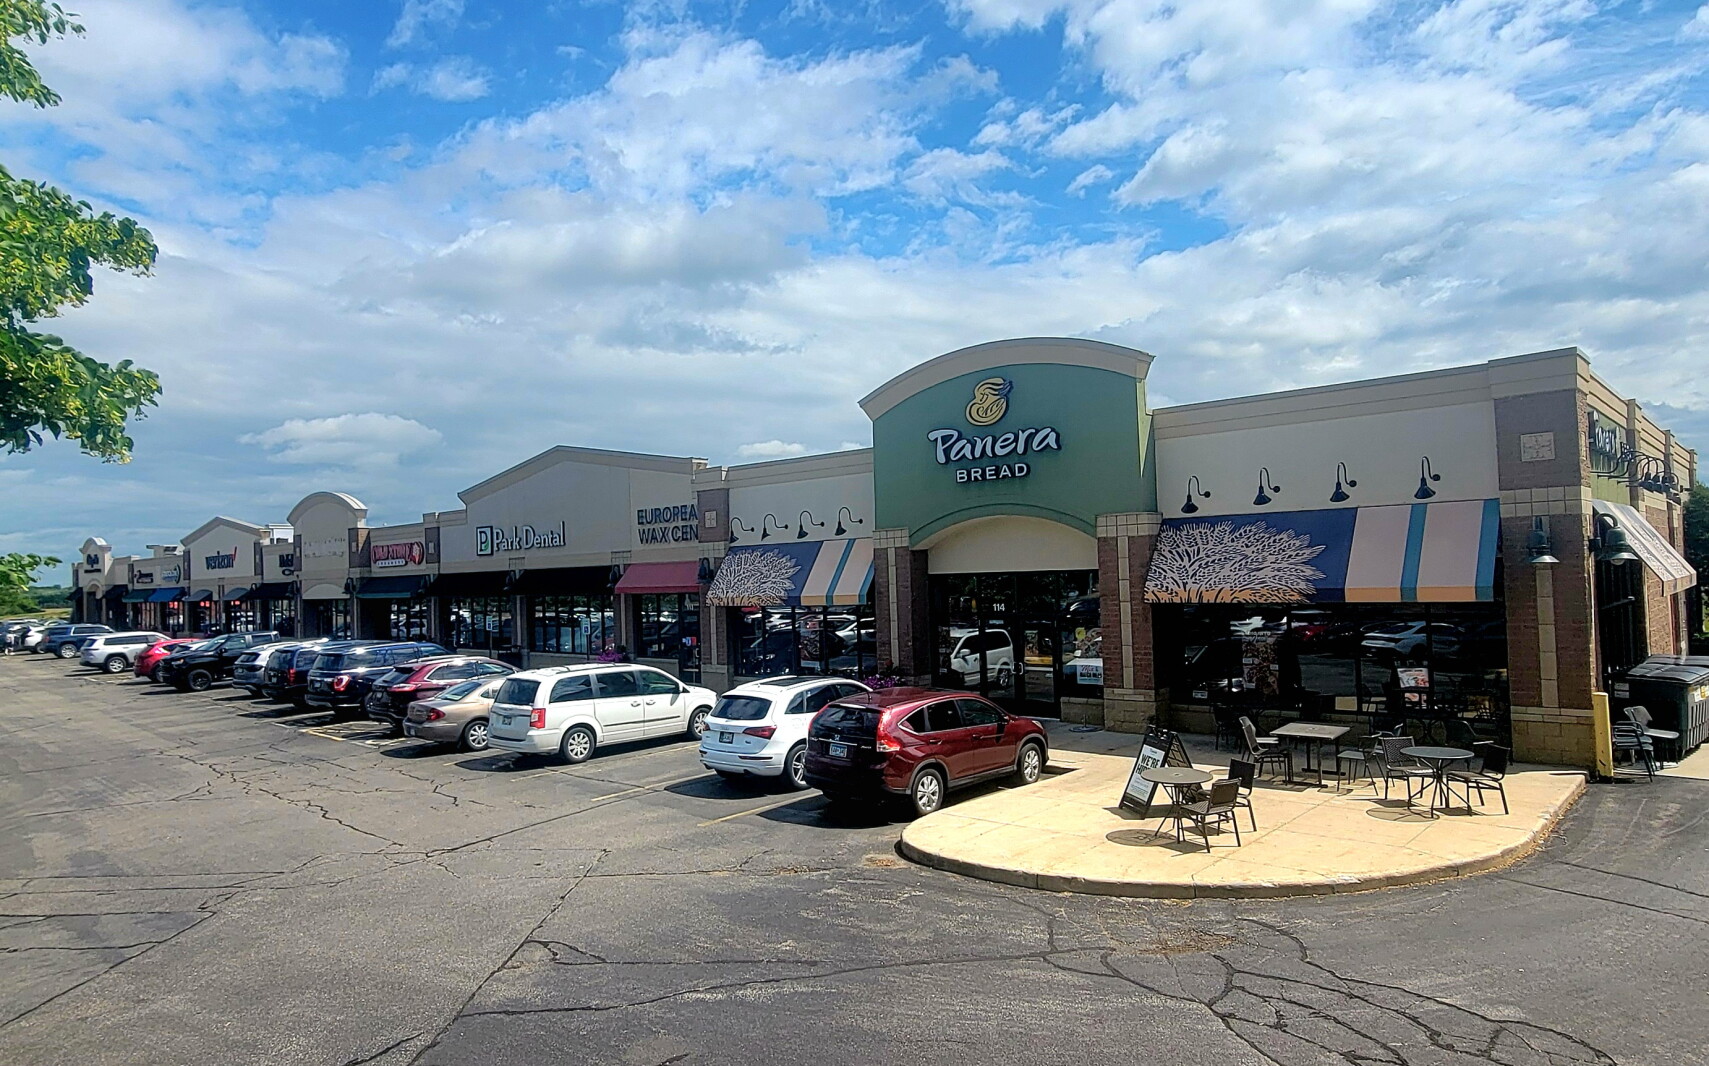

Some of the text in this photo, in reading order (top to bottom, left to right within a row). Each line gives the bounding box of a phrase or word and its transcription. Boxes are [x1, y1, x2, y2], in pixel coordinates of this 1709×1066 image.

[927, 427, 1060, 464] Panera
[956, 463, 1029, 482] BREAD
[637, 504, 698, 526] EUROPEA
[495, 520, 566, 552] Park Dental
[638, 524, 698, 545] WAX CEN
[205, 551, 234, 570] verizon
[993, 603, 1006, 613] 114
[1141, 754, 1160, 769] WE'RE
